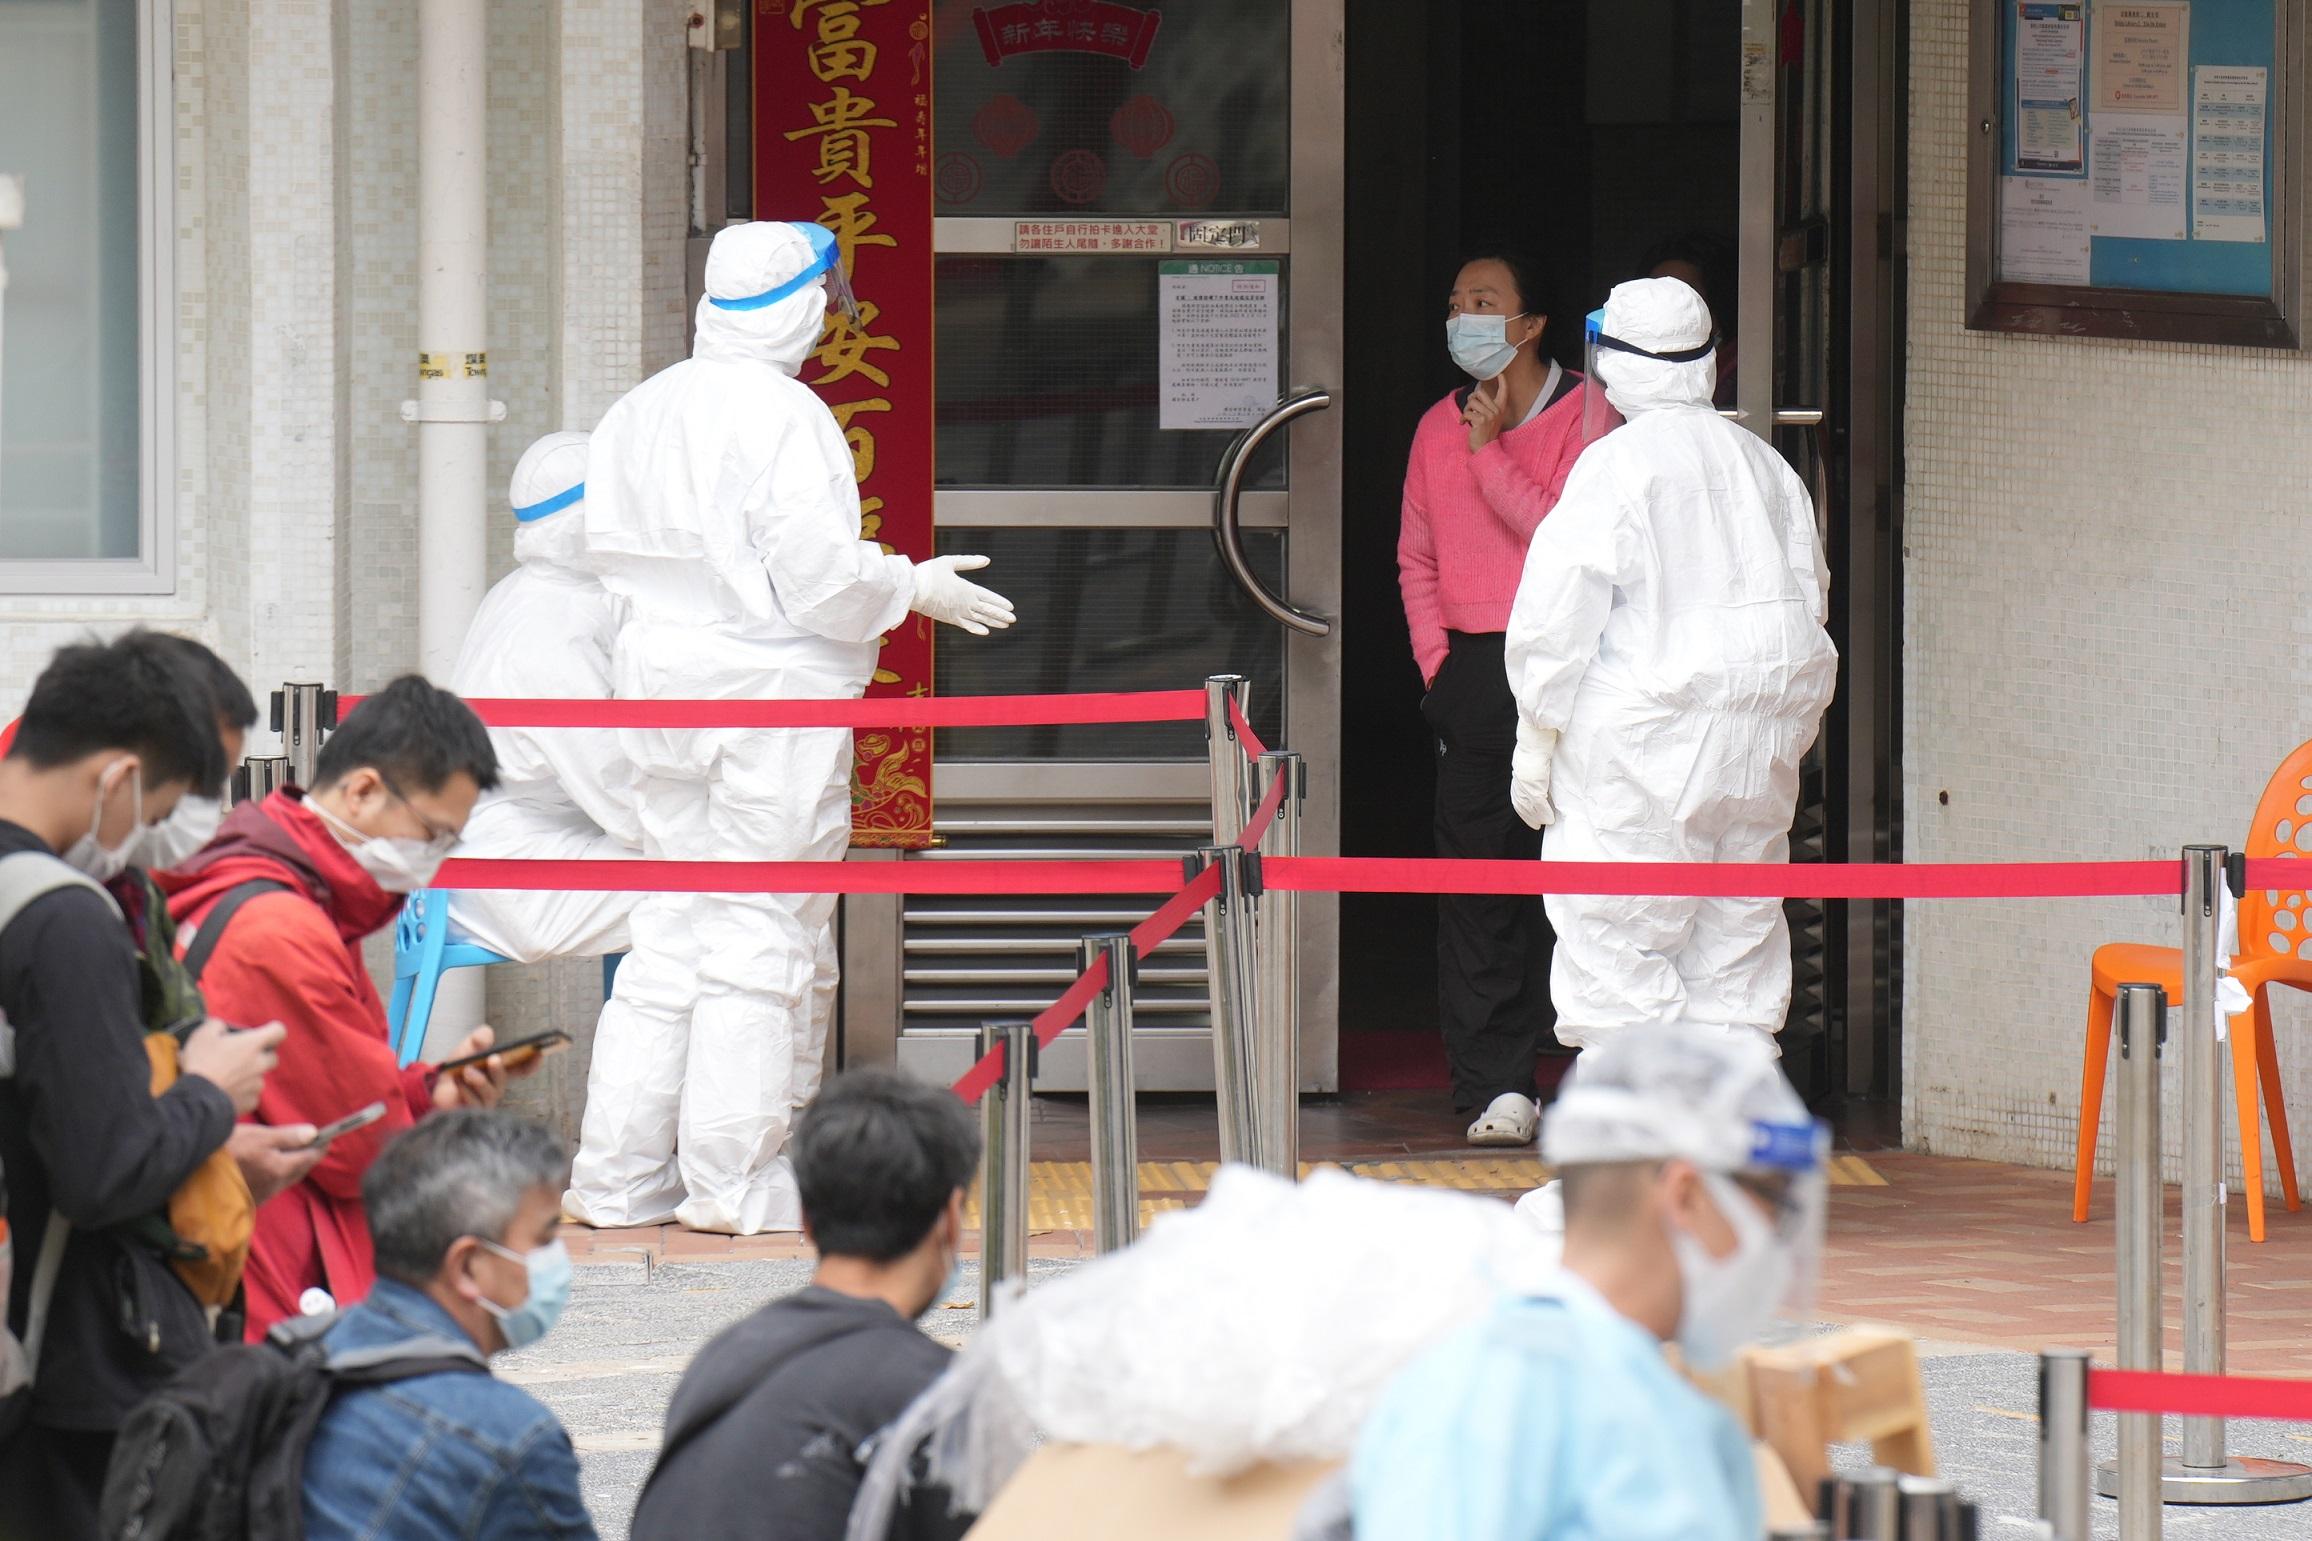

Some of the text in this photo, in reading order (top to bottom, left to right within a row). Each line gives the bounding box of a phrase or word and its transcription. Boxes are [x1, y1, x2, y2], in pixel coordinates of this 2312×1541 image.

[1001, 18, 1128, 46] 新年快樂
[1200, 264, 1232, 273] NOTICE
[784, 0, 901, 684] 富貴平安百
